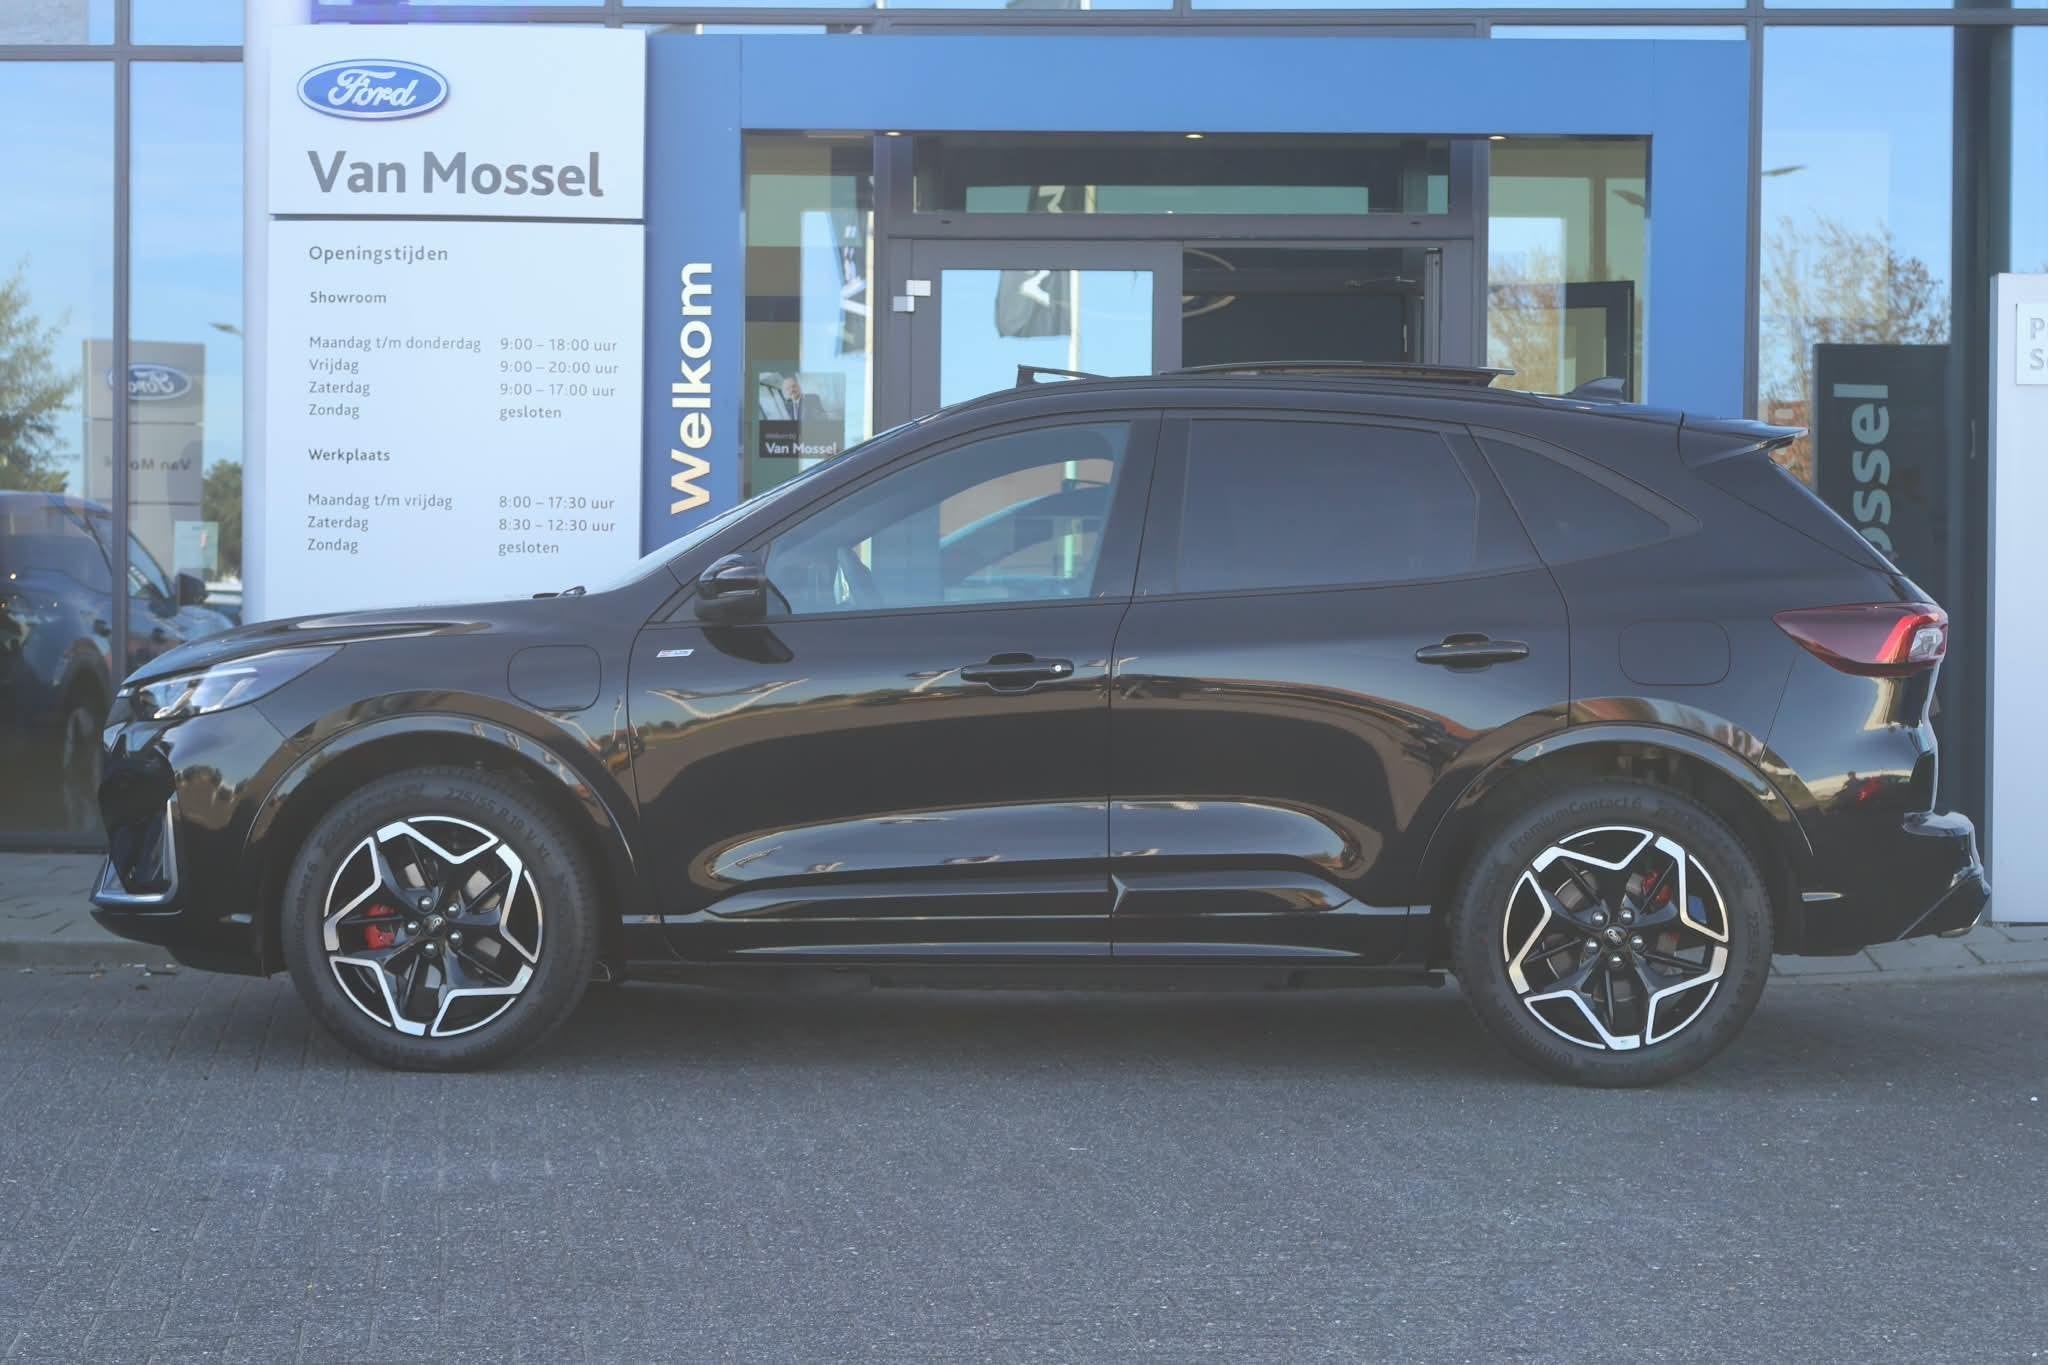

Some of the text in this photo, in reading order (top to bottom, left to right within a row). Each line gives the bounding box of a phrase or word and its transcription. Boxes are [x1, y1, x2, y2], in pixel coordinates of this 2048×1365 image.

[328, 68, 418, 106] Ford
[306, 147, 604, 197] Van Mossel
[308, 242, 448, 264] Openingstijden
[308, 288, 387, 304] Showroom
[2029, 317, 2048, 340] P
[309, 336, 373, 353] Maandag
[375, 336, 402, 349] t/m
[405, 336, 482, 353] donderdag
[500, 337, 534, 353] 9:00
[547, 337, 590, 354] 18:00
[593, 342, 618, 352] uur
[308, 358, 360, 376] Vrijdag
[500, 360, 534, 375] 9:00
[547, 360, 592, 376] 20:00
[594, 362, 619, 376] uur
[2029, 348, 2048, 370] S
[308, 380, 371, 398] Zaterdag
[499, 382, 534, 397] 9:00
[548, 382, 589, 398] 17:00
[591, 384, 616, 398] uur
[671, 263, 712, 515] Welkom
[308, 403, 562, 421] Zondag gesloten
[308, 448, 391, 464] Werkplaats
[765, 441, 837, 455] Van Mossel
[308, 492, 370, 510] Maandag
[373, 494, 400, 507] t/m
[404, 493, 453, 512] vrijdag
[499, 496, 533, 510] 8:00
[546, 496, 587, 511] 17:30
[590, 497, 615, 512] uur
[307, 515, 368, 532] Zaterdag
[499, 517, 533, 533] 8:30
[546, 518, 589, 534] 12:30
[591, 519, 616, 534] uur
[307, 537, 559, 557] Zondag gesloten
